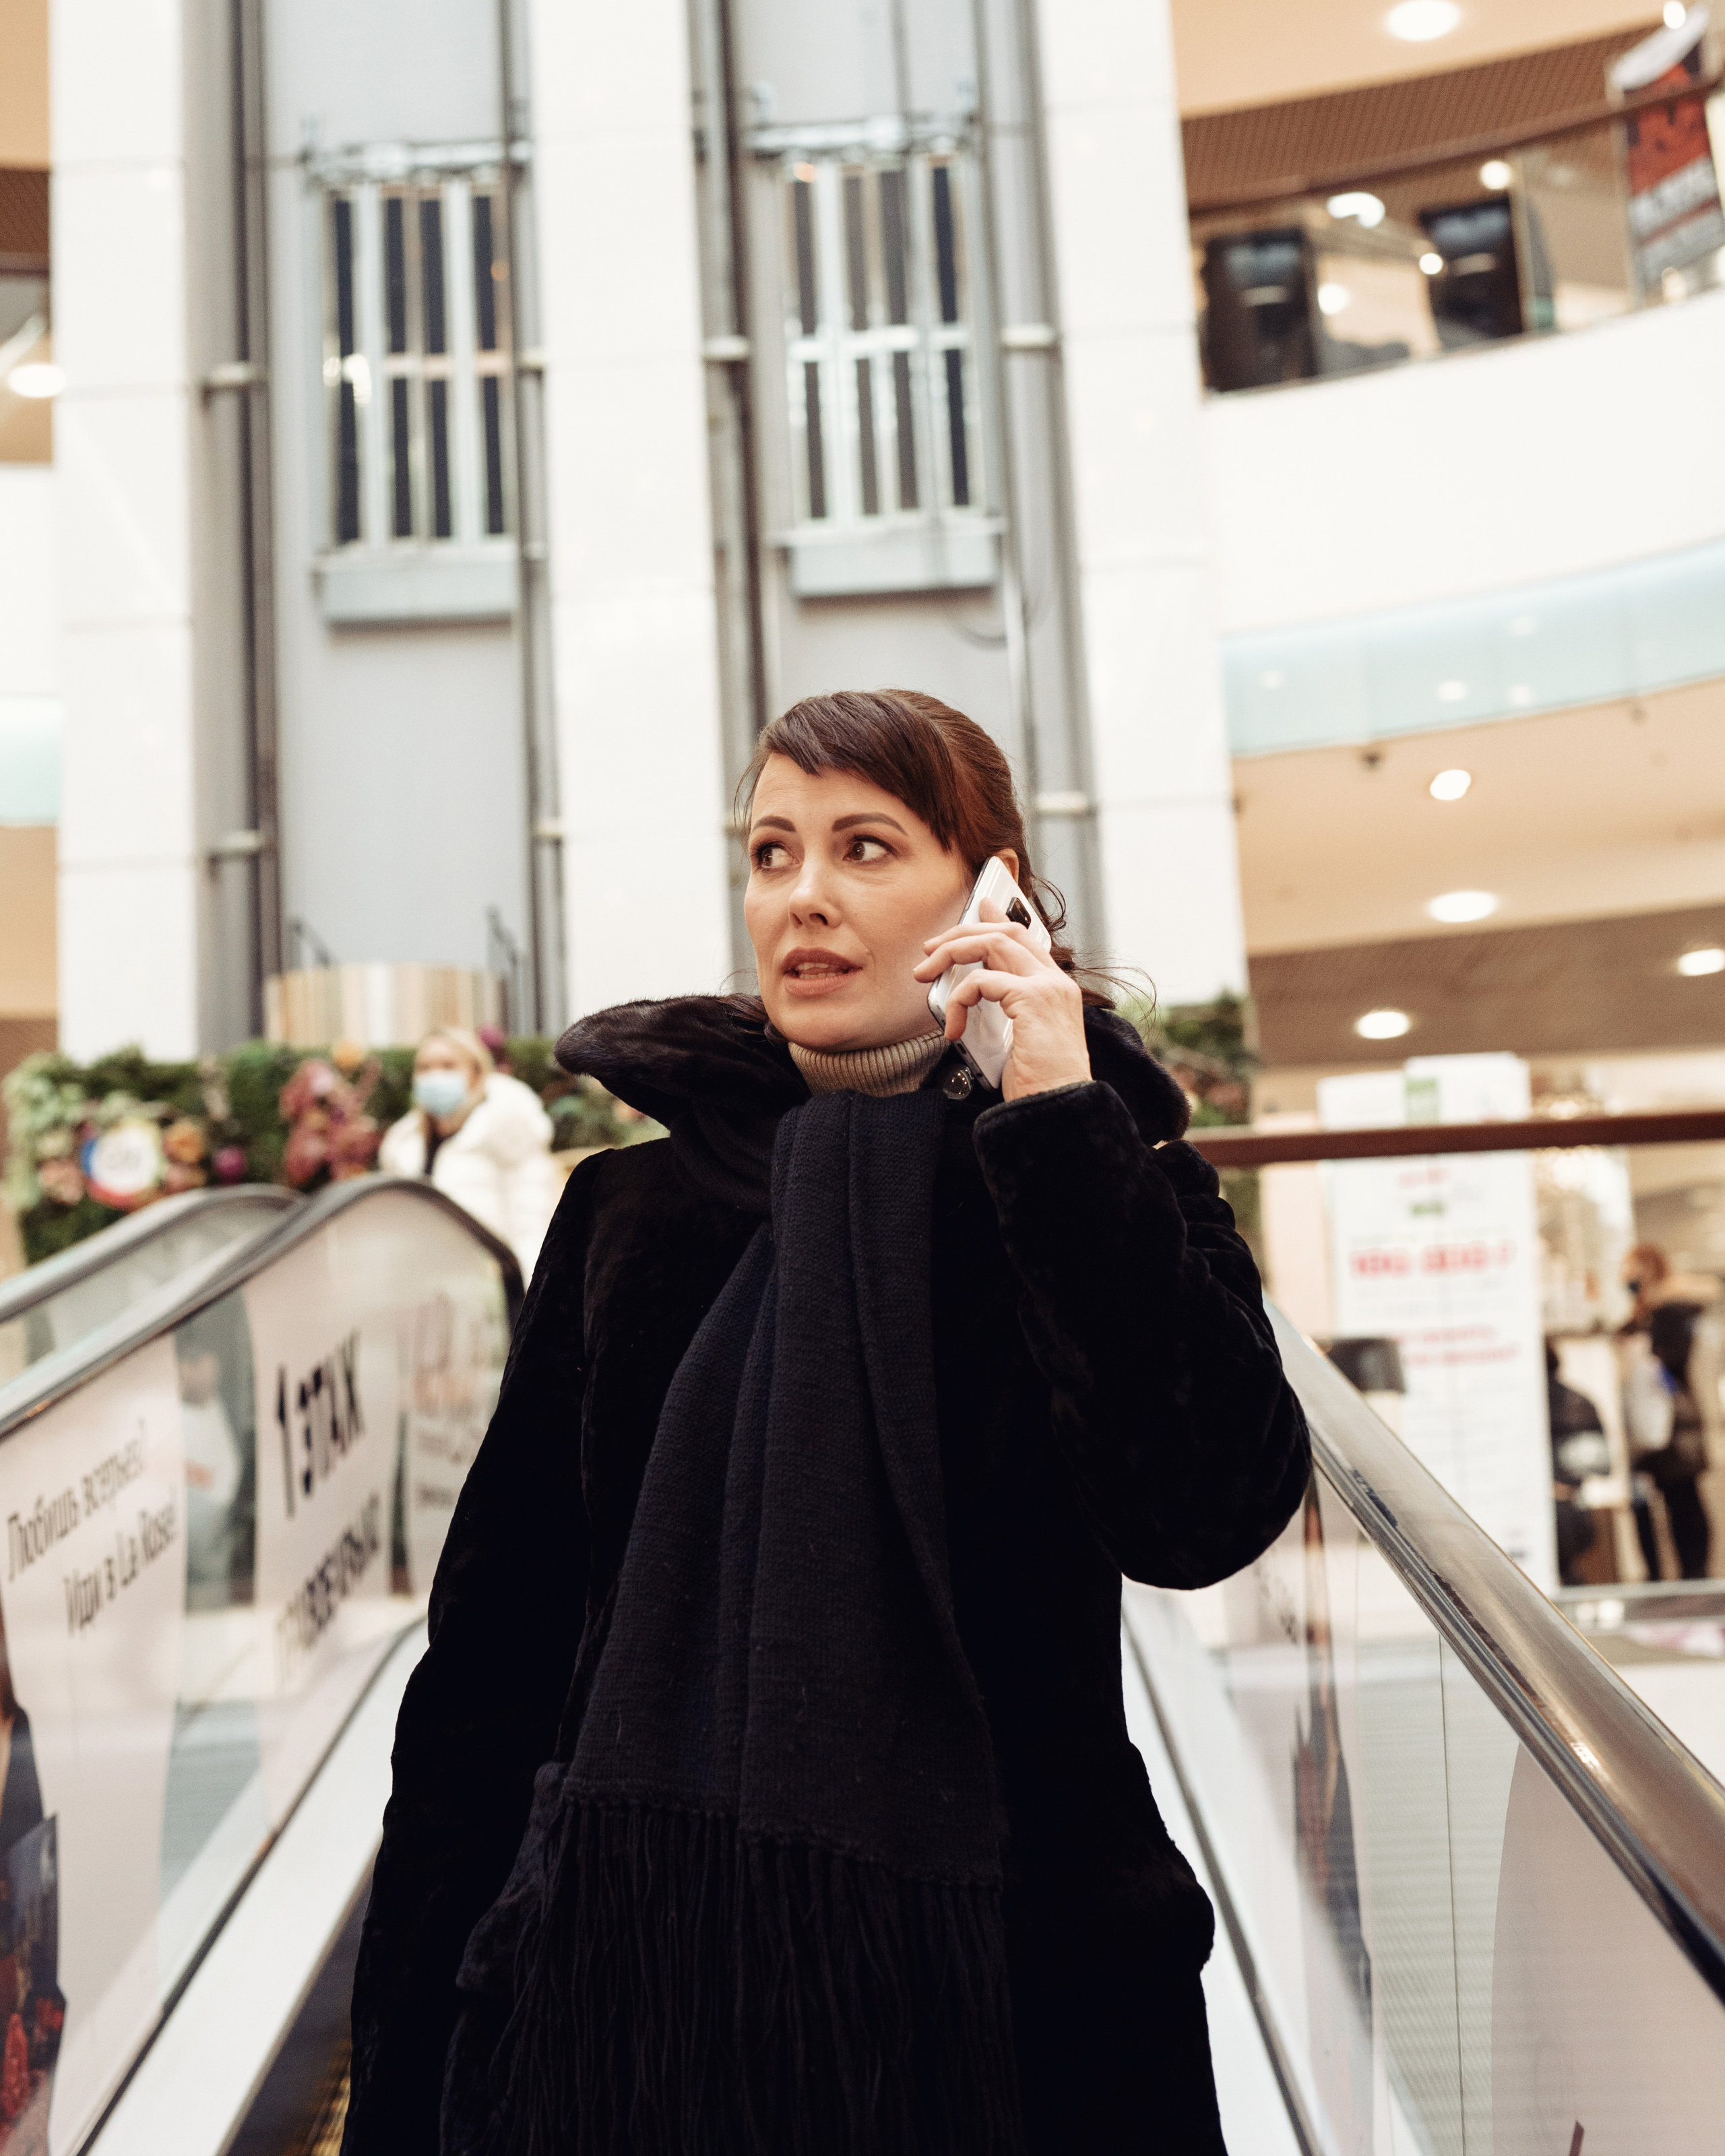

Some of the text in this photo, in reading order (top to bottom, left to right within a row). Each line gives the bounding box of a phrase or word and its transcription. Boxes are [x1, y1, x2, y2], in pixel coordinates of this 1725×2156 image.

[274, 1362, 296, 1520] 1
[7, 1487, 79, 1583] Любишь
[103, 1556, 115, 1601] в
